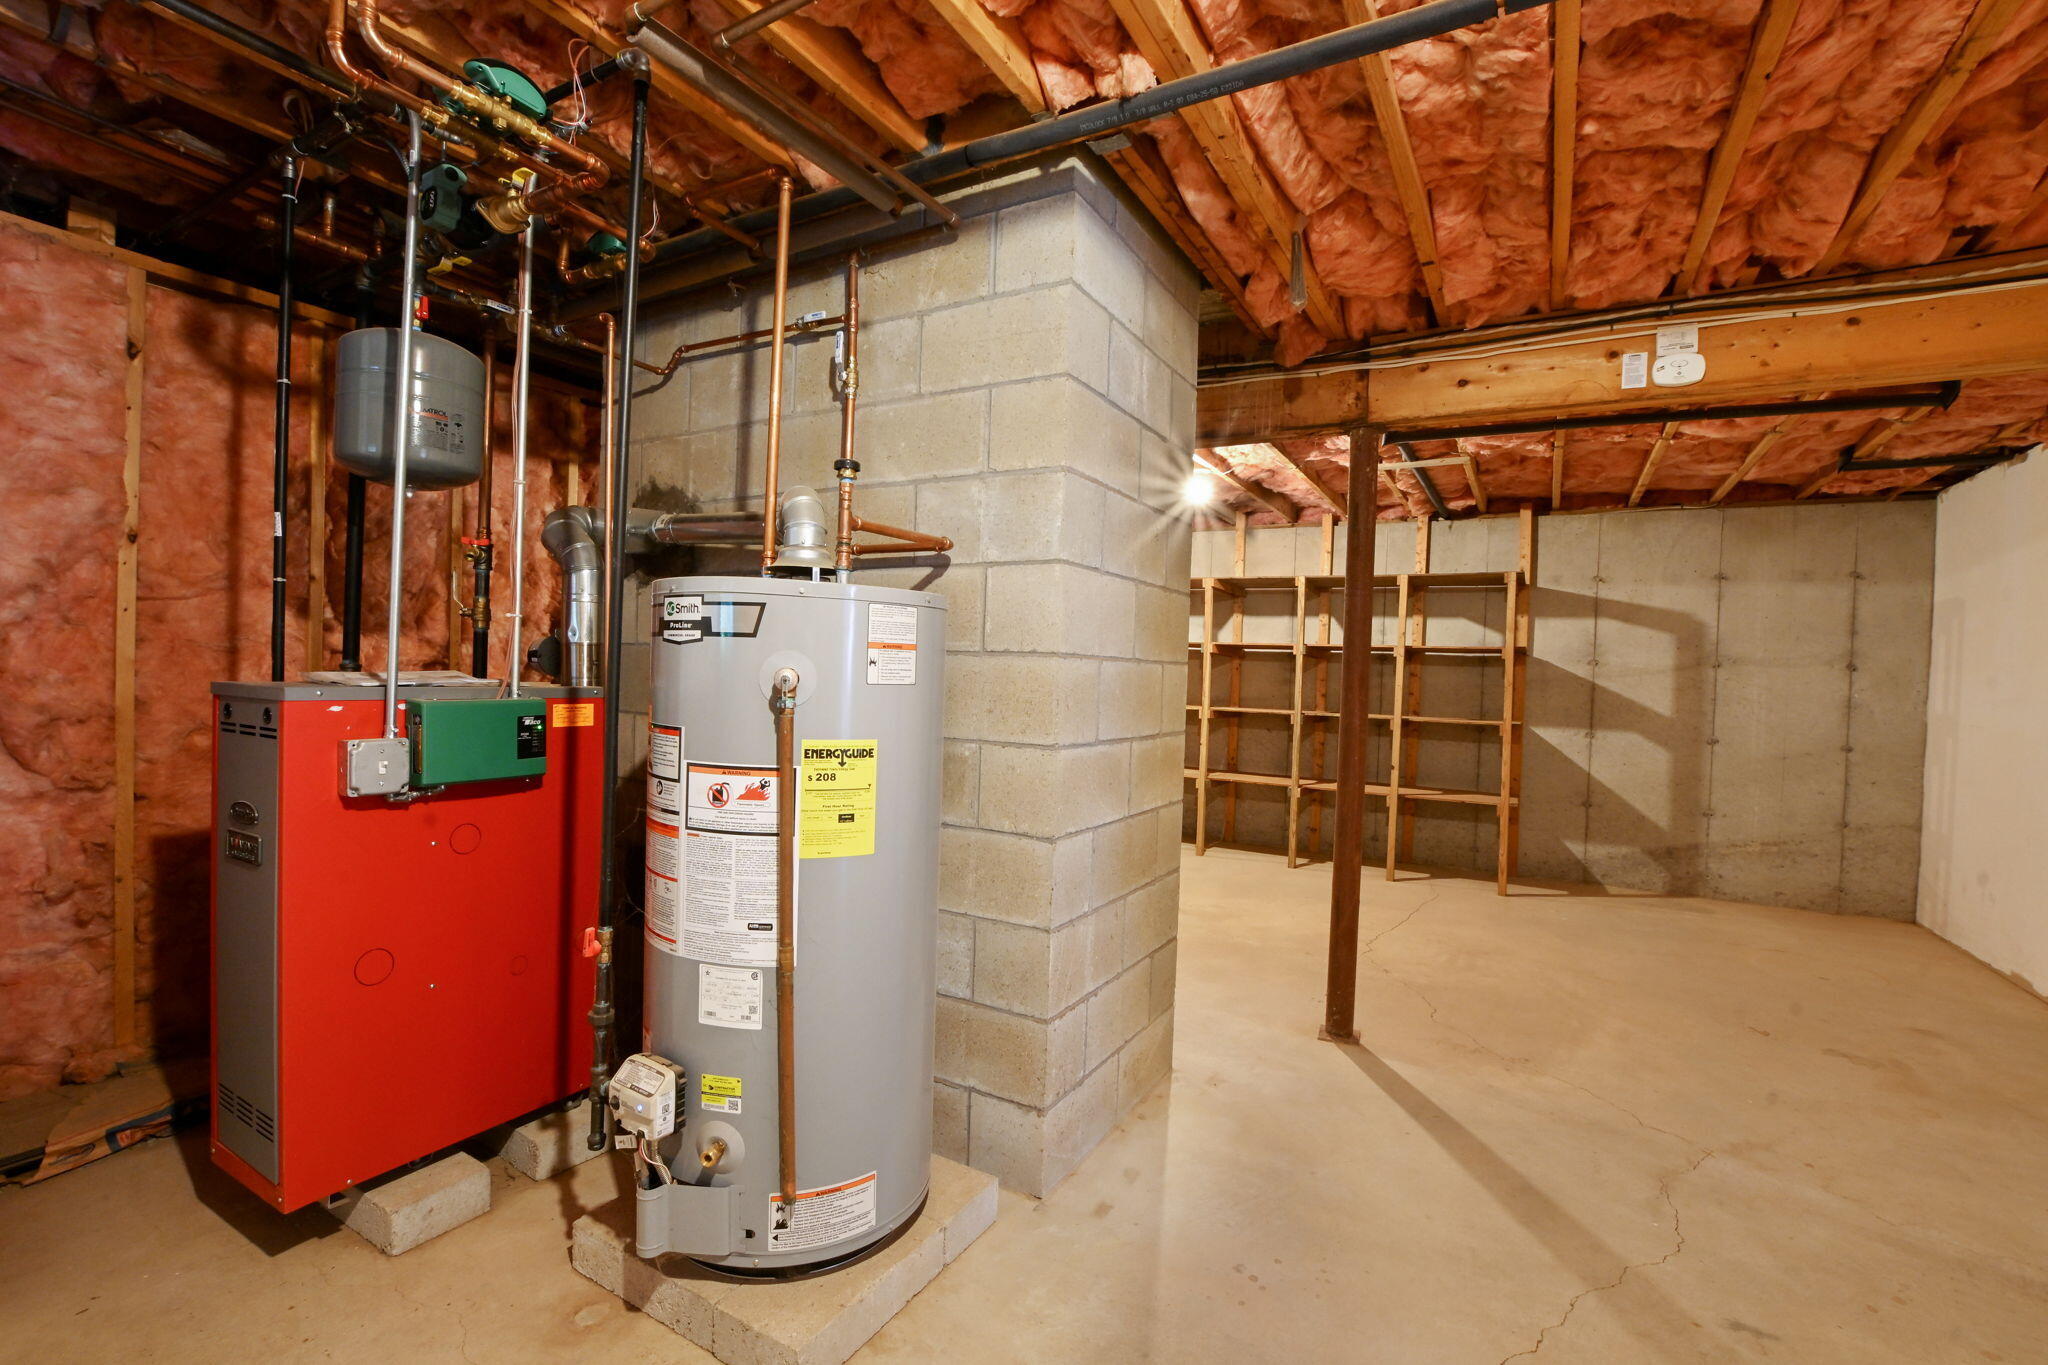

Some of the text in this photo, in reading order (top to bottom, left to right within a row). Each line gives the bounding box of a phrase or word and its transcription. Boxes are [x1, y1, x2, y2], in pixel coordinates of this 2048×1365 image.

[804, 748, 875, 761] ENERGYGUIDE
[807, 772, 837, 782] $ 208
